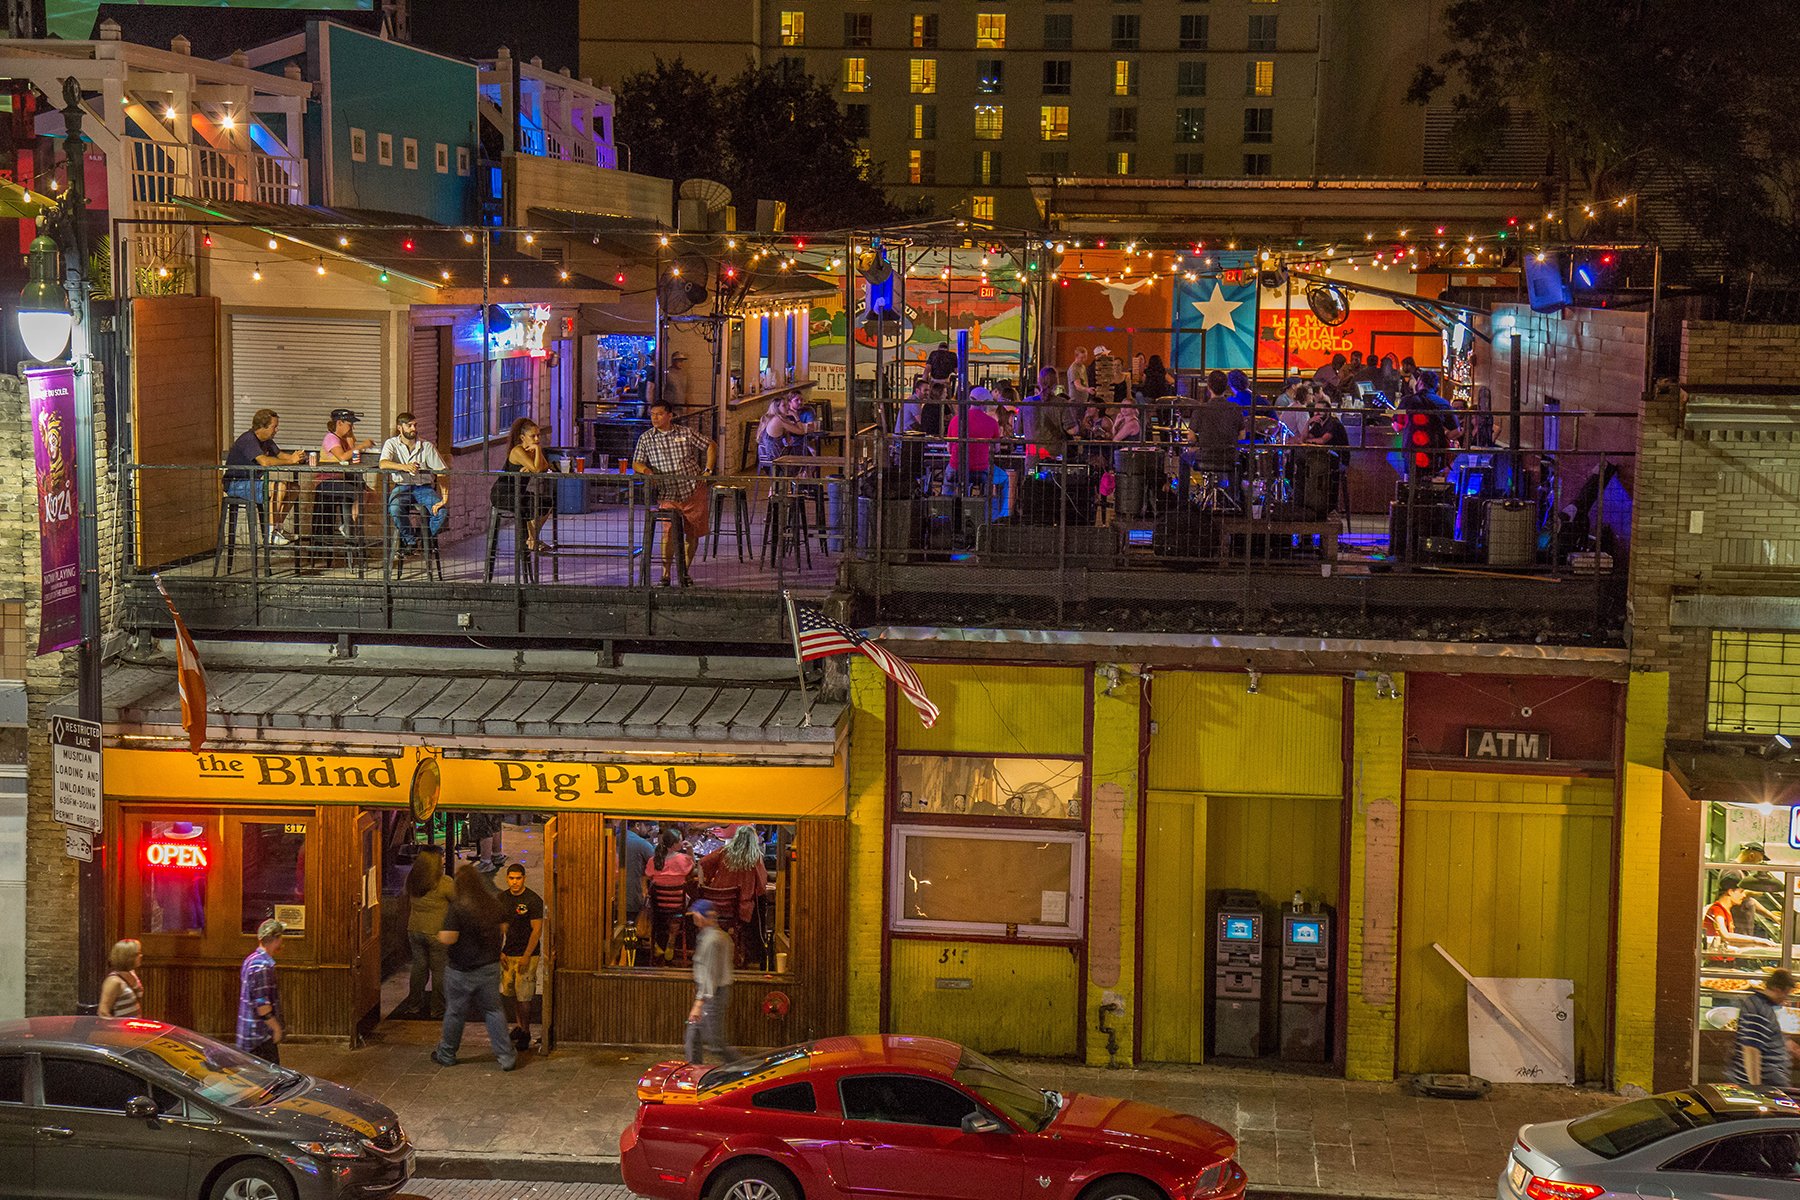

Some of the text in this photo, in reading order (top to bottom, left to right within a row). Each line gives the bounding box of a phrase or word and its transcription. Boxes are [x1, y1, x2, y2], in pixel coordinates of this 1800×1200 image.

[981, 287, 994, 297] EXIT
[1276, 327, 1340, 340] CAPITAL
[1297, 339, 1353, 351] WORLD
[65, 722, 100, 738] RESTRICTED
[75, 736, 91, 748] LANE
[1477, 732, 1539, 759] ATM
[63, 749, 92, 764] MUSICIAN
[55, 764, 99, 782] LOADING AND
[197, 754, 696, 801] the Blind Pig Pub
[60, 781, 96, 798] UNLOADING
[56, 809, 74, 821] PERMIT
[285, 824, 306, 833] 317
[147, 844, 207, 867] OPEN
